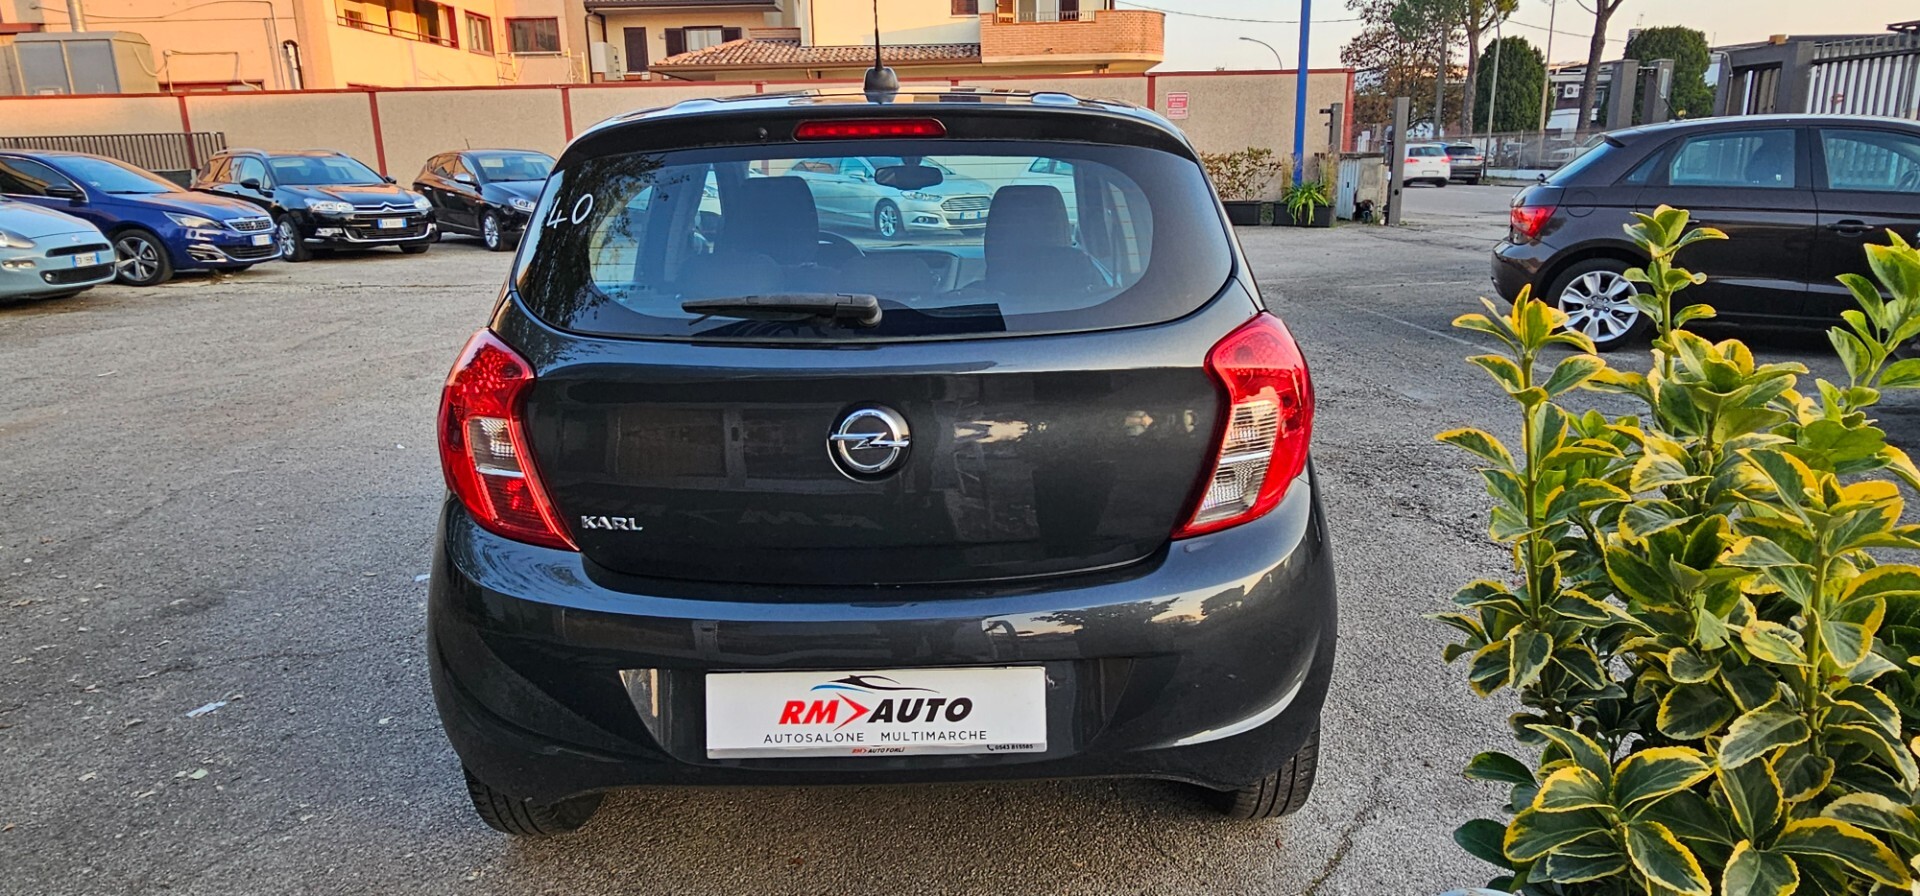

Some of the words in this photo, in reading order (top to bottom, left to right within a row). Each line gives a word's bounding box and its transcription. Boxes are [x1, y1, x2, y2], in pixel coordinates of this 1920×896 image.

[546, 193, 593, 229] 40
[581, 515, 643, 531] KARL
[779, 699, 840, 725] RM
[867, 697, 973, 723] AUTO
[764, 732, 864, 744] AUTOSALONE
[881, 730, 987, 742] MULTIMARCHE
